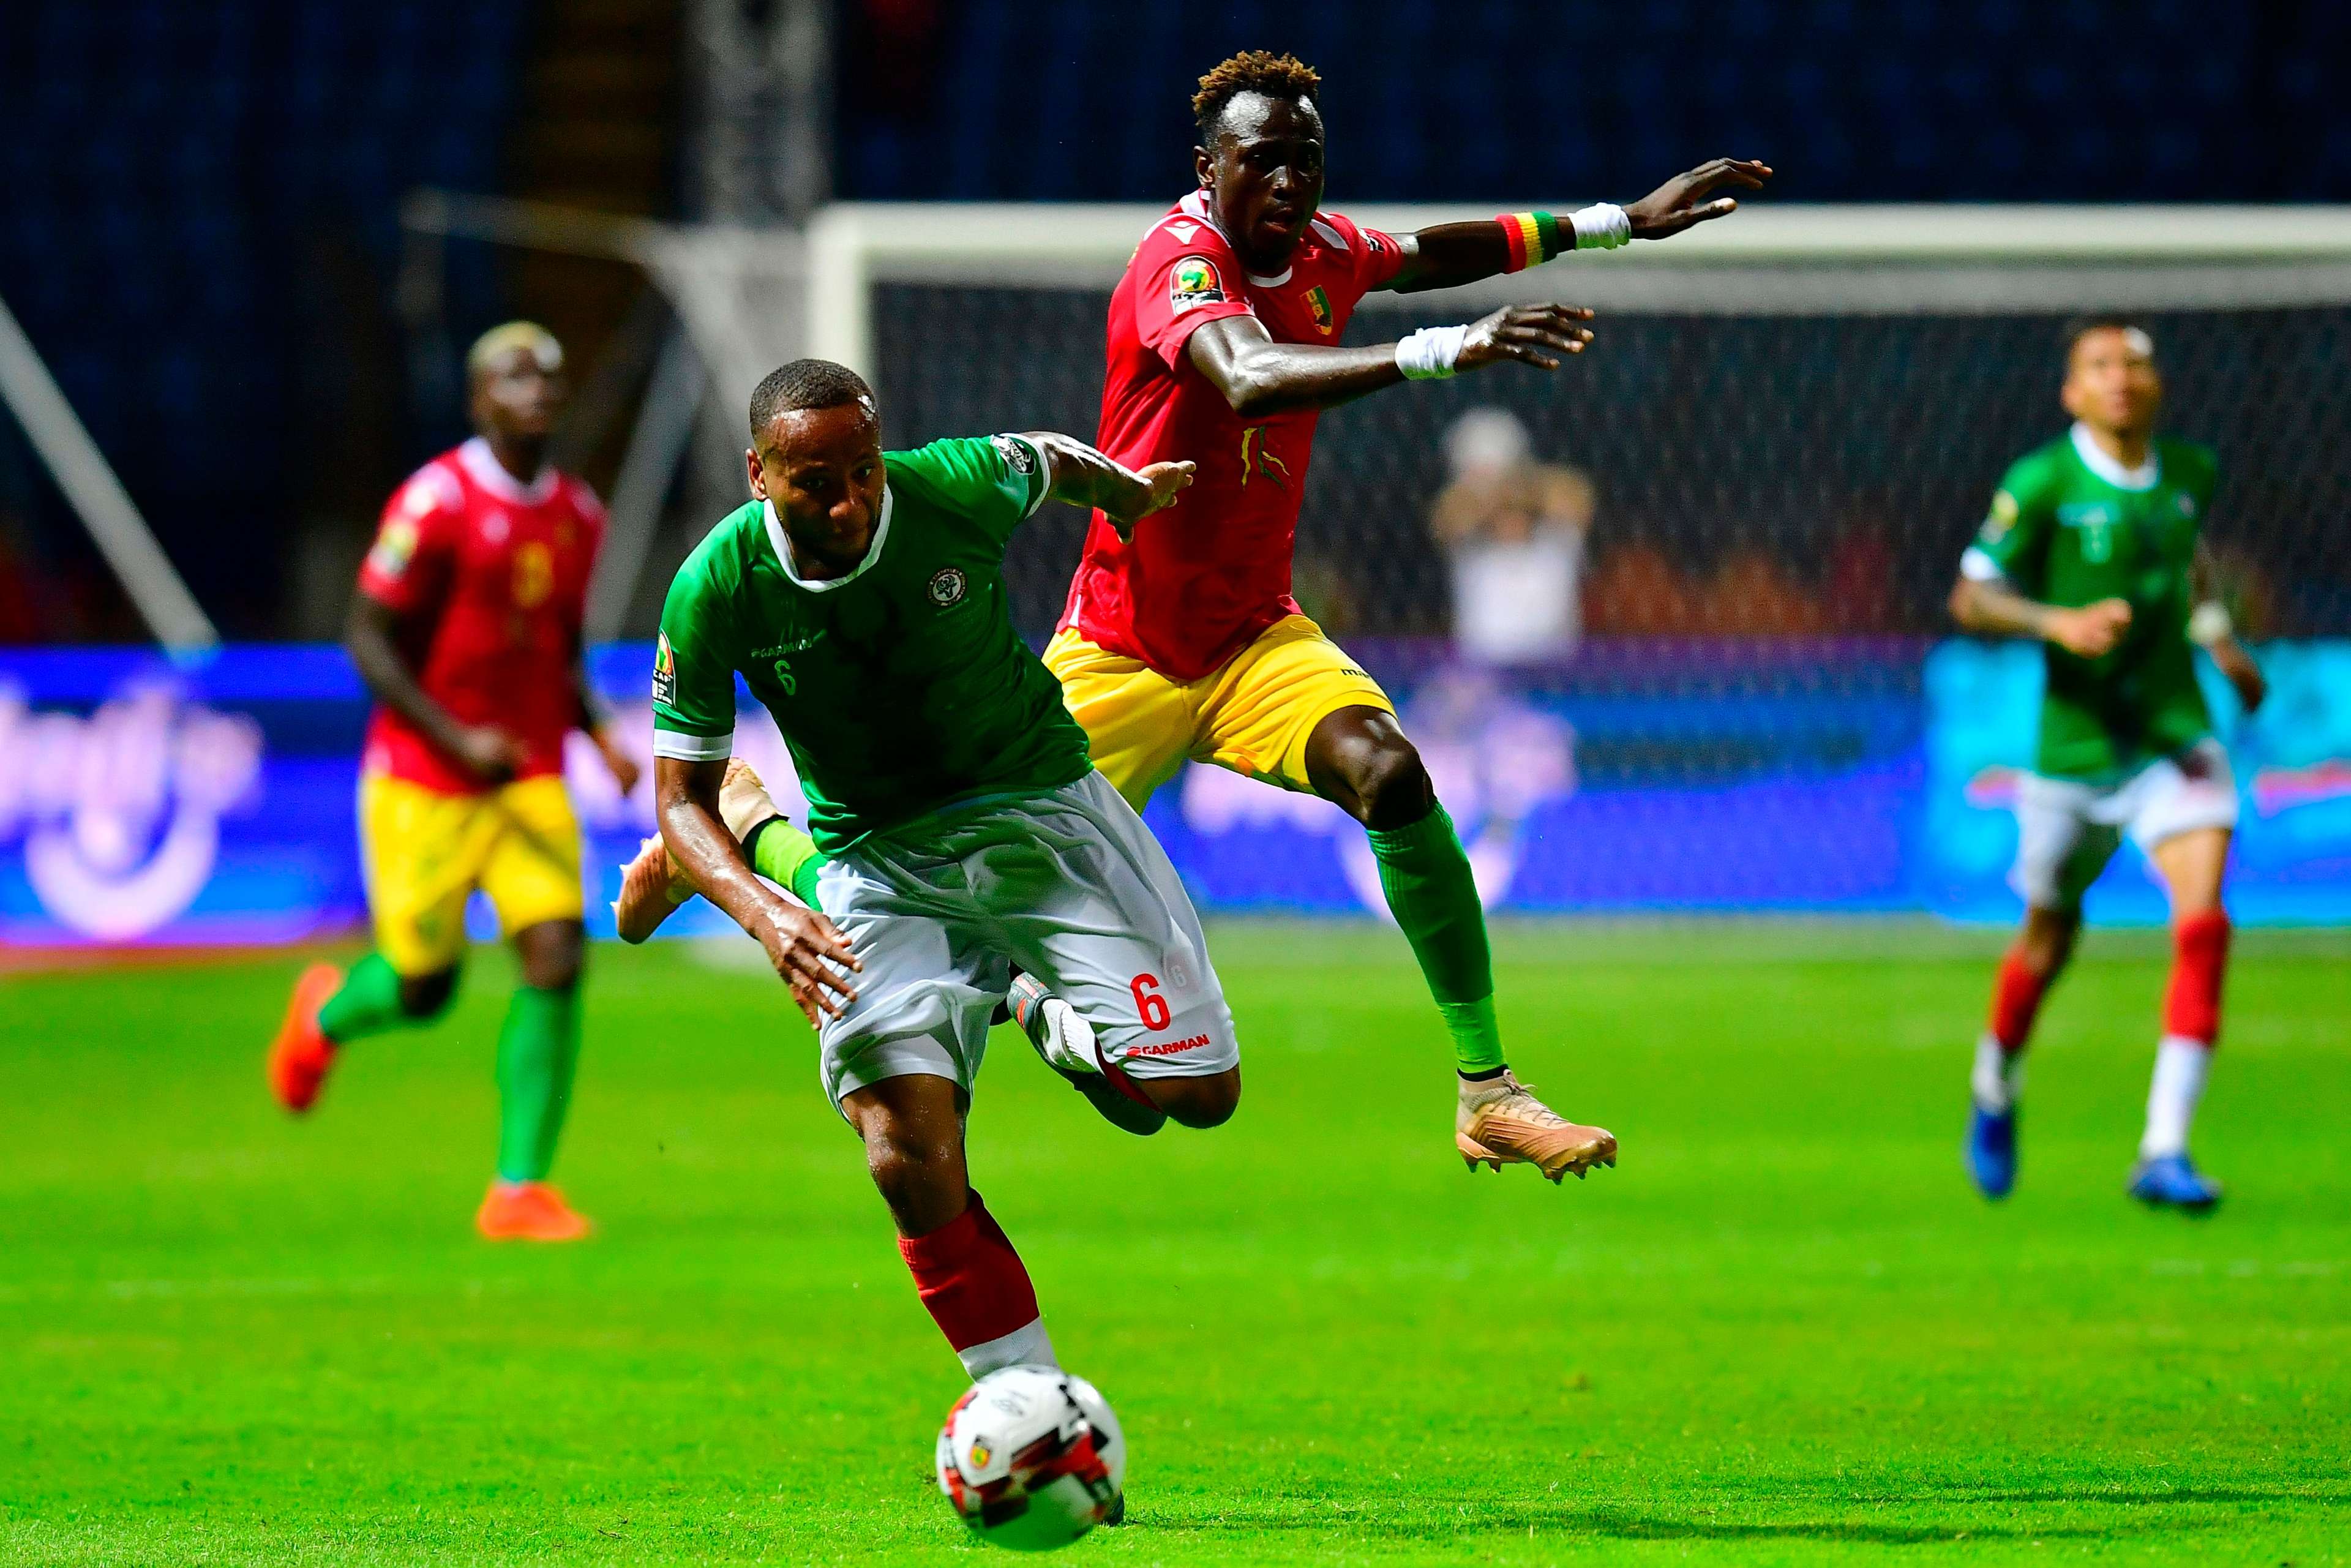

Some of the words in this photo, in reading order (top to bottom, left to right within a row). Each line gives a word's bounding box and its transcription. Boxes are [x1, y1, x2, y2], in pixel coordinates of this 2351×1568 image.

[774, 660, 796, 696] 6
[1129, 972, 1171, 1032] 6
[1142, 1033, 1210, 1056] GARMAN
